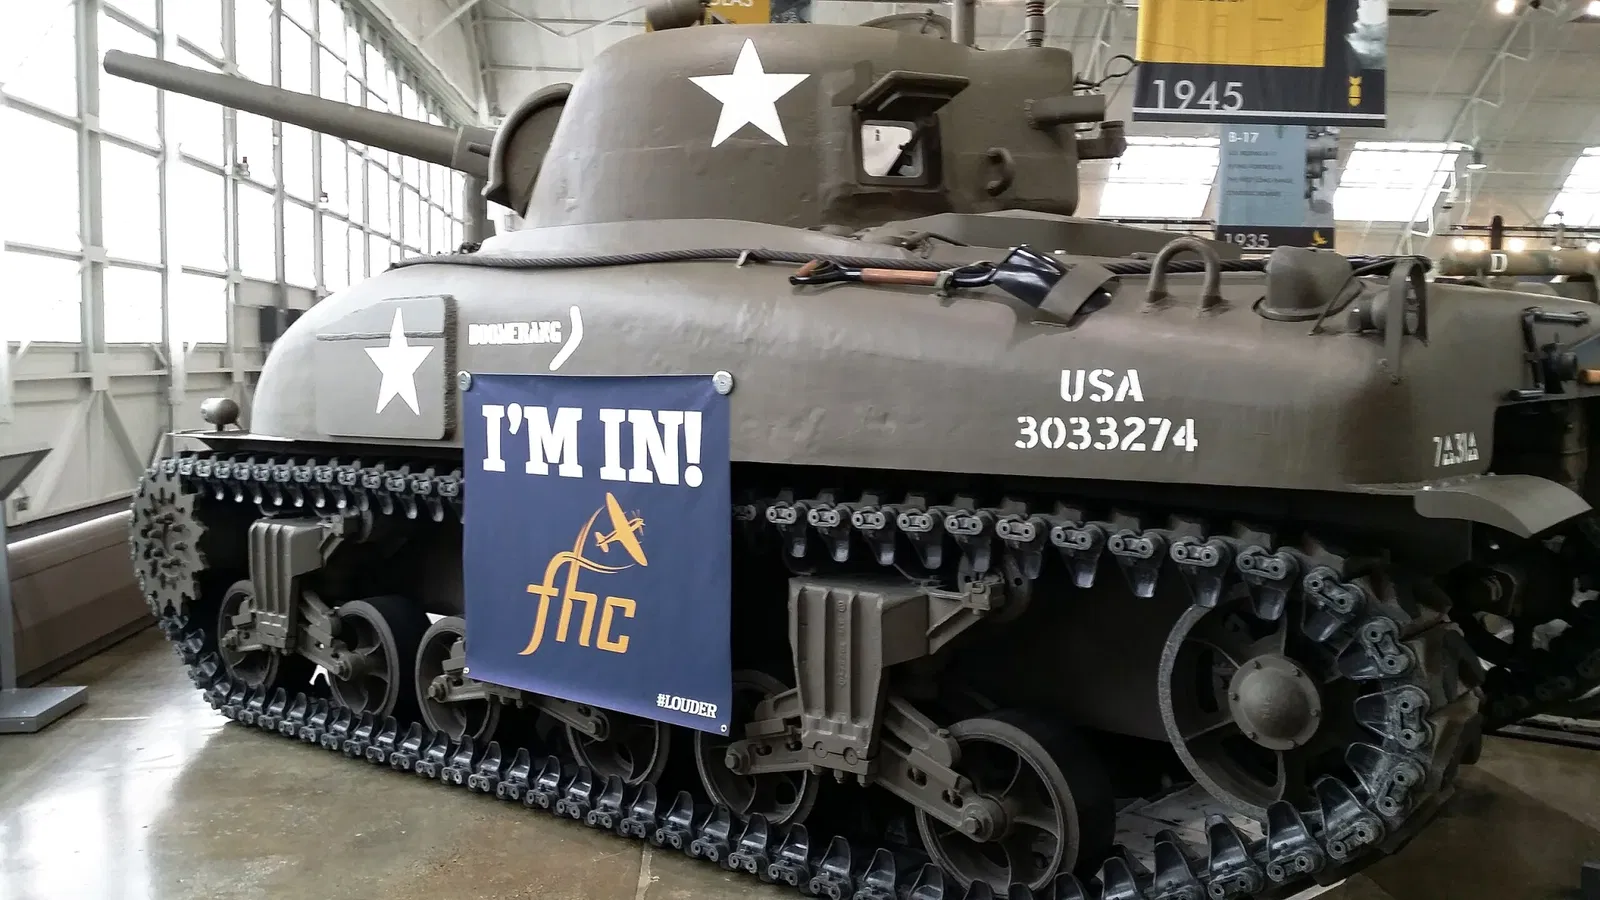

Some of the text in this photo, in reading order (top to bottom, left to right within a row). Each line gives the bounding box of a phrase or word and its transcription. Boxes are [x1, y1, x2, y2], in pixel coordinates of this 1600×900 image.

[1152, 79, 1245, 111] 1945
[1228, 131, 1260, 143] B-17
[1224, 233, 1270, 248] 1935
[1490, 253, 1508, 272] D
[468, 321, 562, 345] BOOMERANG
[1060, 368, 1144, 402] USA
[482, 402, 703, 488] I'M IN!
[1014, 416, 1198, 451] 3033274
[518, 525, 636, 655] fhc
[656, 693, 717, 718] #LOUDER
